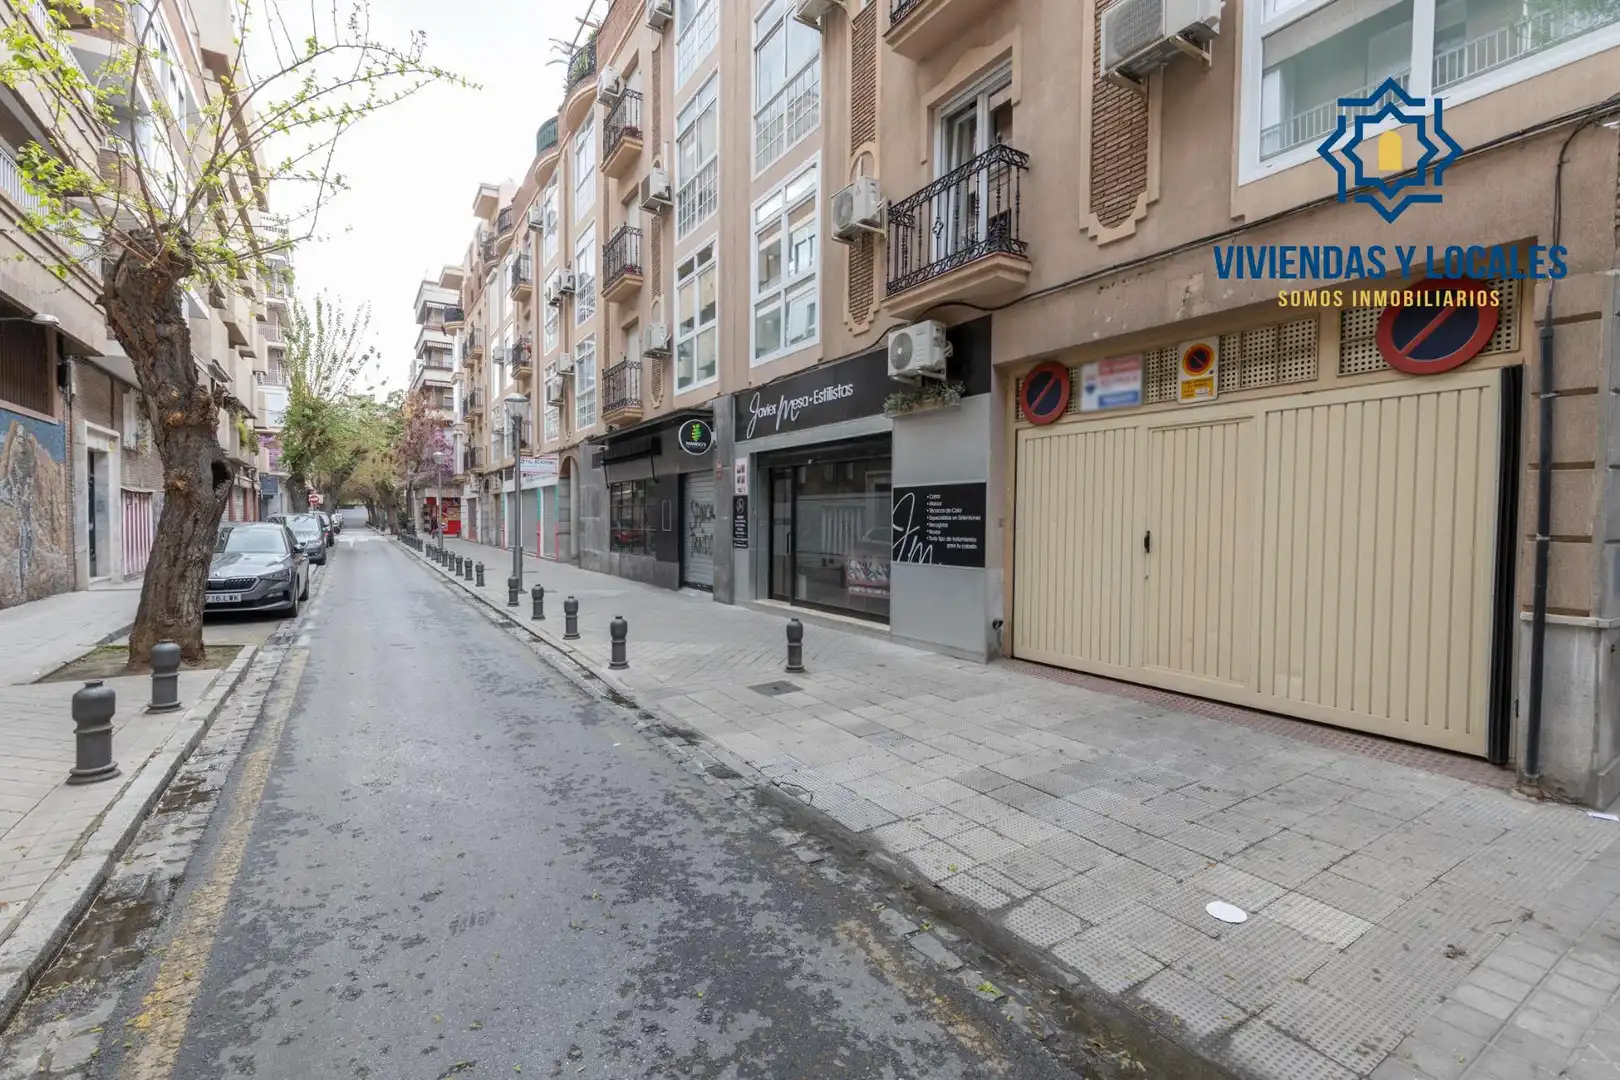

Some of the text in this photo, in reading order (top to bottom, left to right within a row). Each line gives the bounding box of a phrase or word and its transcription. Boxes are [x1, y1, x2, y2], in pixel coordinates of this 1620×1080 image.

[746, 383, 854, 439] Javier Mesa Estilistas
